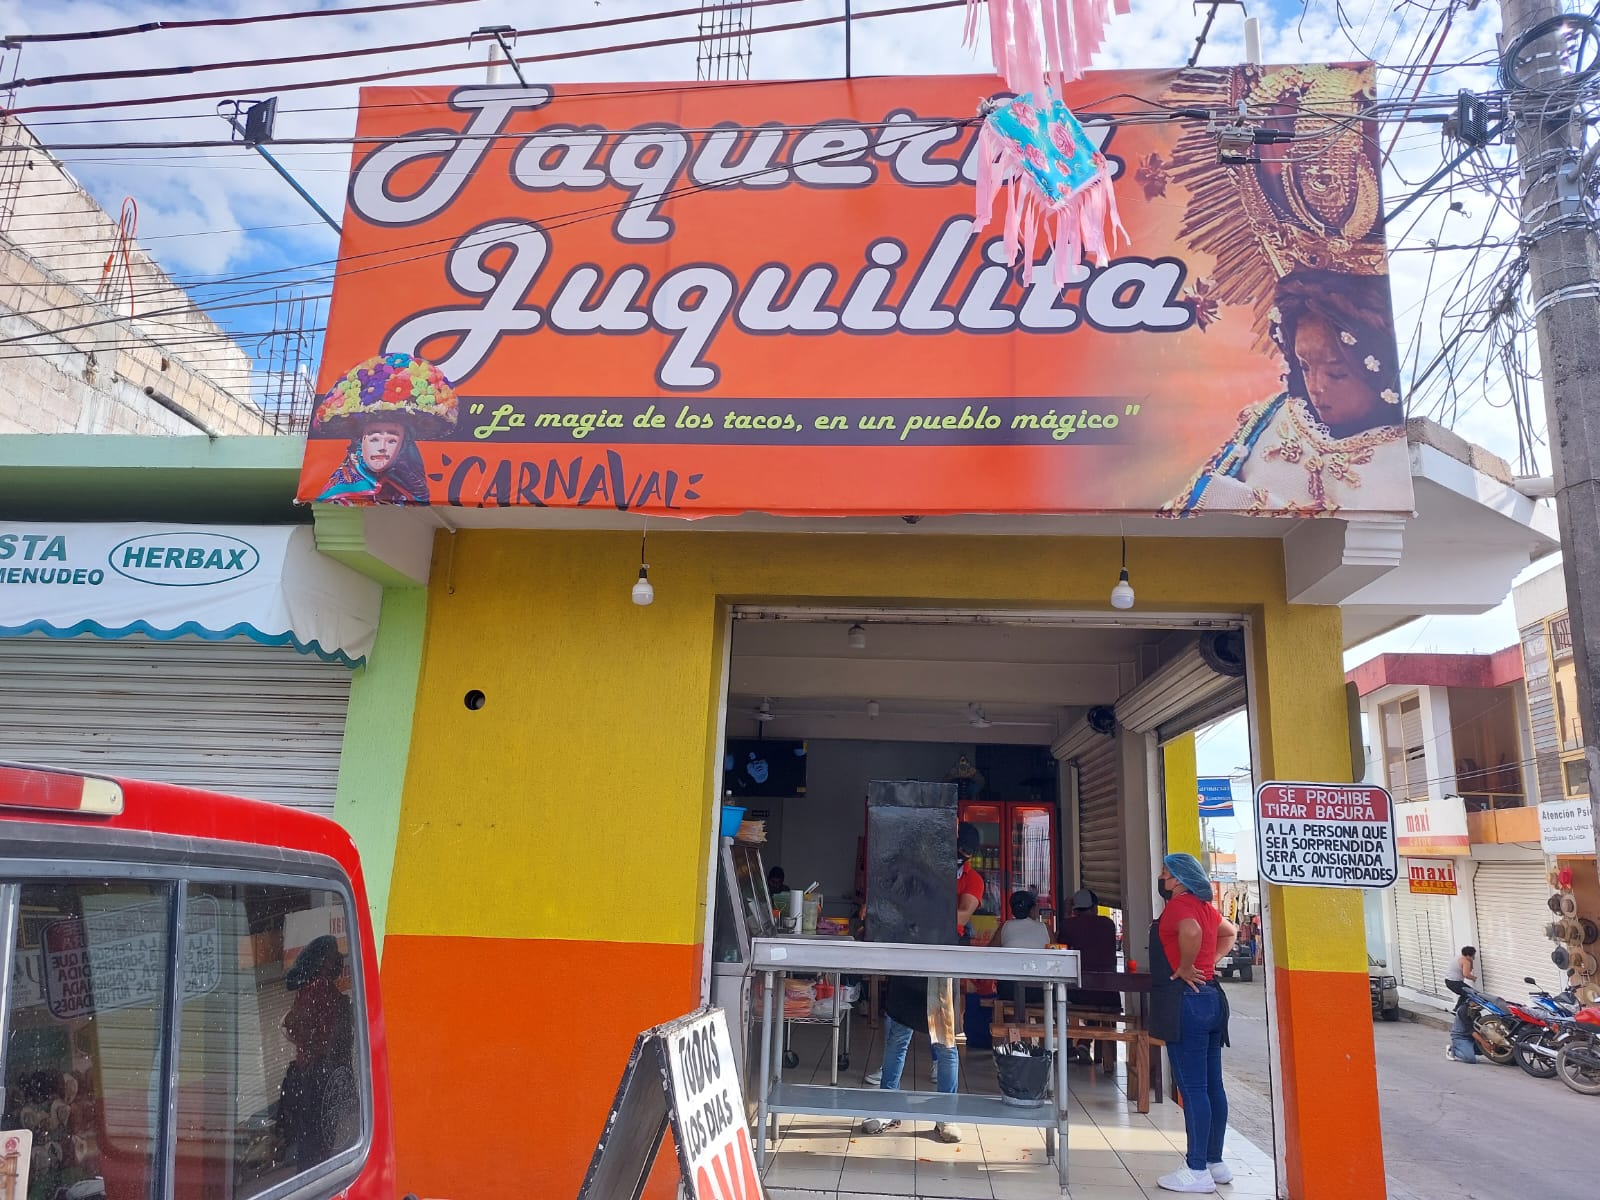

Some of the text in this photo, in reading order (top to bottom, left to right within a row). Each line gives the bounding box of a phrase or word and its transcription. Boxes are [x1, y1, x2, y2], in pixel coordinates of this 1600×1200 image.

[349, 84, 1125, 243] Taquer
[381, 214, 1198, 391] Juquilita
[534, 409, 624, 439] magia
[633, 405, 666, 429] de
[675, 405, 714, 429] los
[723, 410, 804, 433] tacos,
[814, 414, 849, 430] en
[858, 413, 896, 430] un
[900, 406, 1002, 441] pueblo
[448, 449, 681, 511] CARNAVAL
[122, 547, 248, 570] HERBAX
[1278, 789, 1372, 805] SE PROHIBE
[1265, 803, 1375, 820] TIRAR BASURA
[1405, 807, 1431, 833] maxi
[1542, 808, 1575, 820] Atención
[1265, 823, 1388, 840] A LA PERSONA QUE
[1266, 837, 1384, 853] SEA SORPRENDIDA
[1302, 851, 1383, 867] CONSIGNADA
[1268, 864, 1393, 881] A LAS AUTORIDADES
[1410, 863, 1453, 881] maxi
[1413, 879, 1453, 889] carne
[678, 1021, 721, 1102] TODOS
[684, 1089, 733, 1162] LOS DIAS
